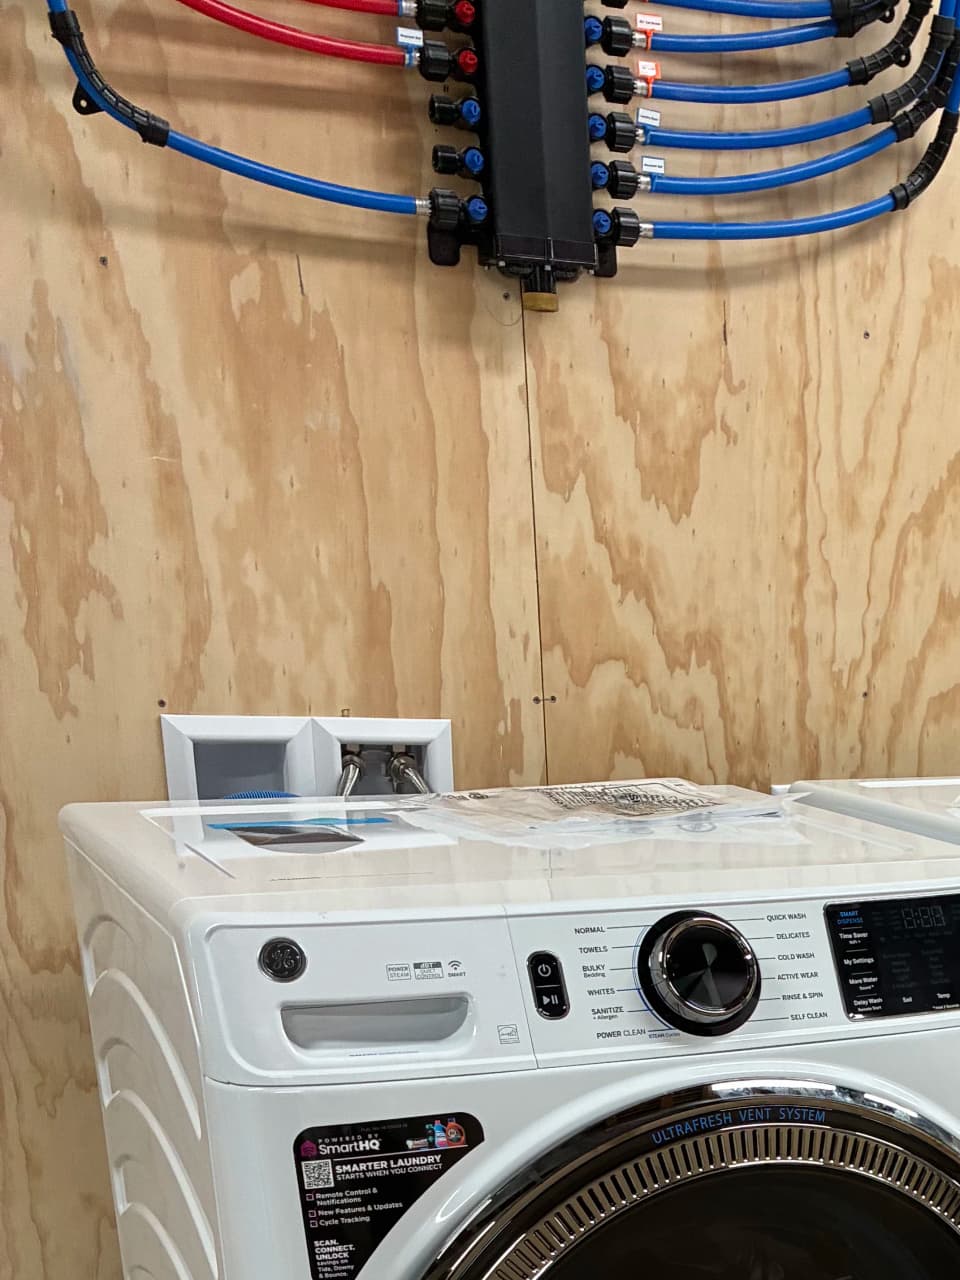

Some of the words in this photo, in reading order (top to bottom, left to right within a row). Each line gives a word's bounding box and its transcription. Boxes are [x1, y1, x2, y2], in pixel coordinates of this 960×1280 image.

[776, 932, 810, 940] DELICATES
[579, 946, 608, 954] TOWELS
[587, 988, 615, 996] WHITES
[782, 993, 802, 1001] RINSE
[592, 1006, 624, 1015] SANITIZE
[597, 1030, 621, 1039] POWER
[623, 1028, 646, 1037] CLEAN
[651, 1112, 732, 1145] ULTRAFRESH
[738, 1108, 771, 1122] VENT
[779, 1107, 826, 1123] SYSTEM
[319, 1135, 362, 1144] POWERED
[336, 1161, 388, 1173] SMARTER
[390, 1154, 442, 1167] LAUNDRY
[336, 1172, 364, 1180] STARTS
[391, 1167, 406, 1175] YOU
[407, 1163, 443, 1173] CONNECT
[345, 1188, 371, 1196] Control
[317, 1197, 361, 1206] Notifications
[373, 1202, 403, 1210] Updates
[340, 1216, 370, 1224] Tracking
[314, 1239, 339, 1247] SCAN.
[315, 1244, 355, 1253] CONNECT.
[316, 1252, 349, 1260] UNLOCK
